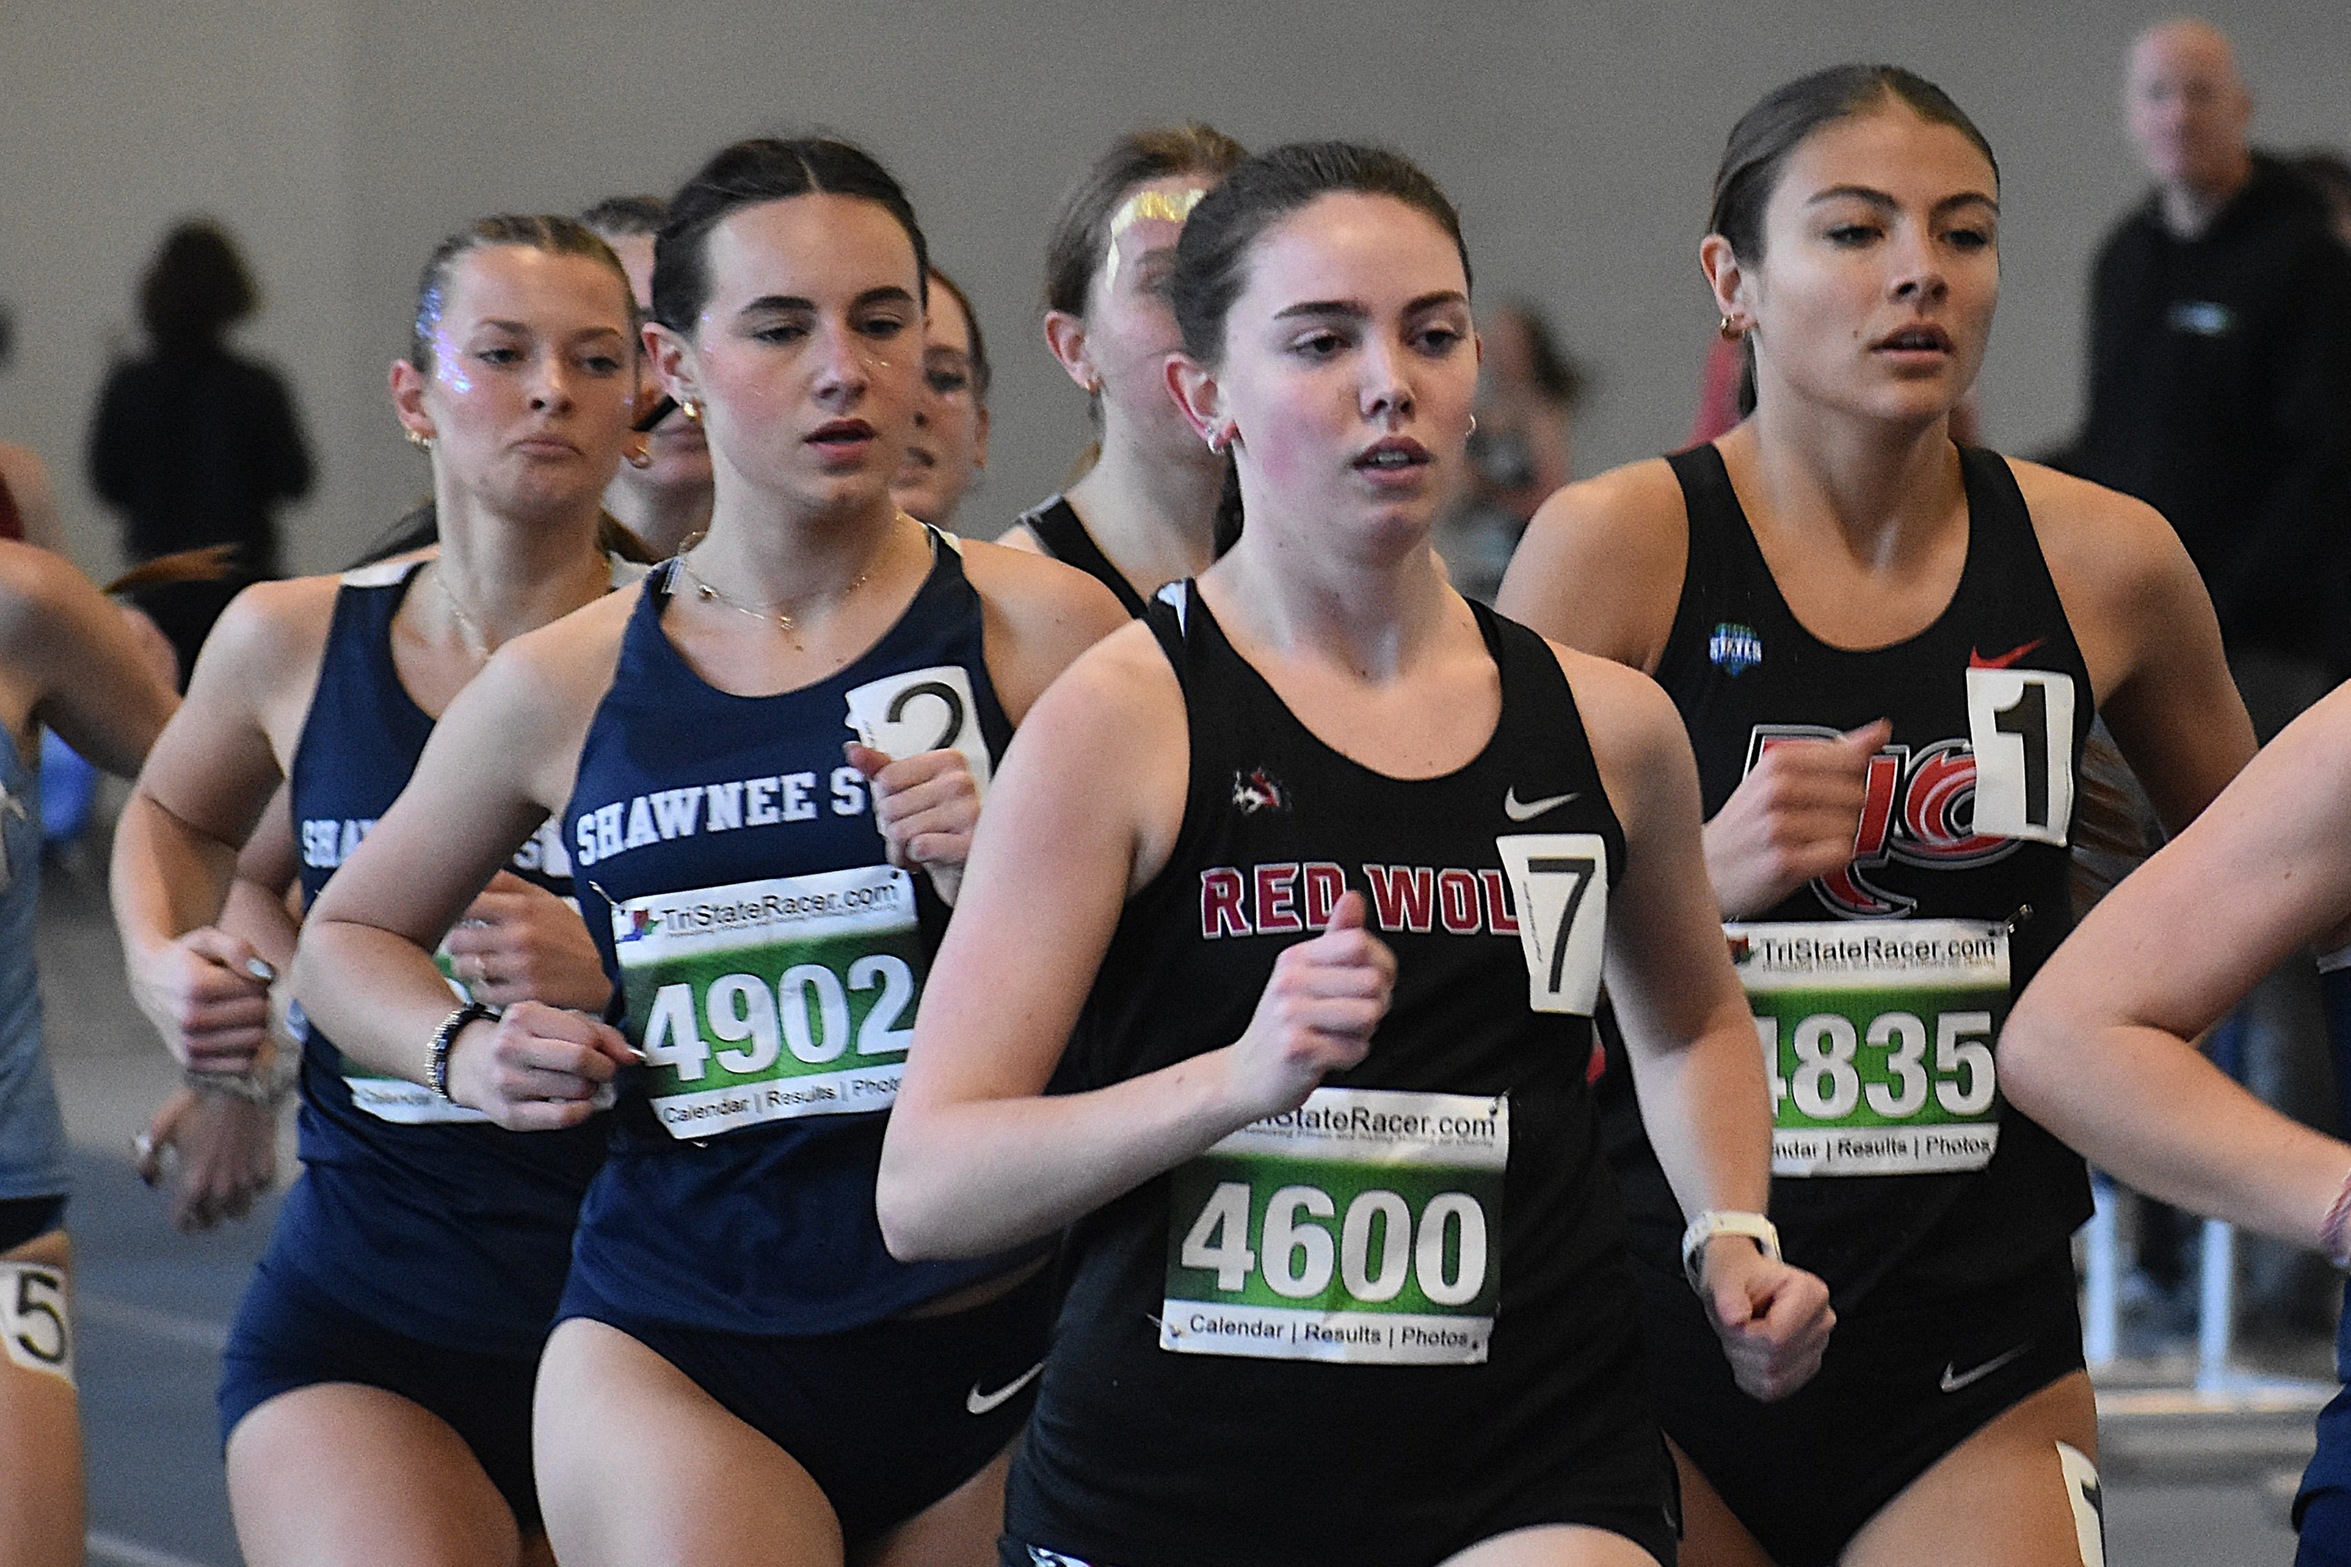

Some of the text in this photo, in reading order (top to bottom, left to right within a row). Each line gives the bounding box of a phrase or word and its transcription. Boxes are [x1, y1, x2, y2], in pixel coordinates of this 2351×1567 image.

[1994, 683, 2048, 828] 1
[576, 771, 818, 867] SHAWNEE
[661, 884, 899, 929] TriStateRacer.com
[1201, 862, 1348, 940] RED
[1528, 857, 1597, 994] 7
[1761, 937, 1996, 962] TriStateRacer.com
[643, 954, 916, 1082] 4902
[663, 1098, 750, 1125] Calendar
[767, 1085, 836, 1109] Results
[1838, 1136, 1908, 1157] Results
[1926, 1134, 1990, 1155] Photos
[1181, 1182, 1488, 1306] 4600
[18, 1269, 66, 1364] 5
[1189, 1314, 1469, 1349] Calendar Results Photos
